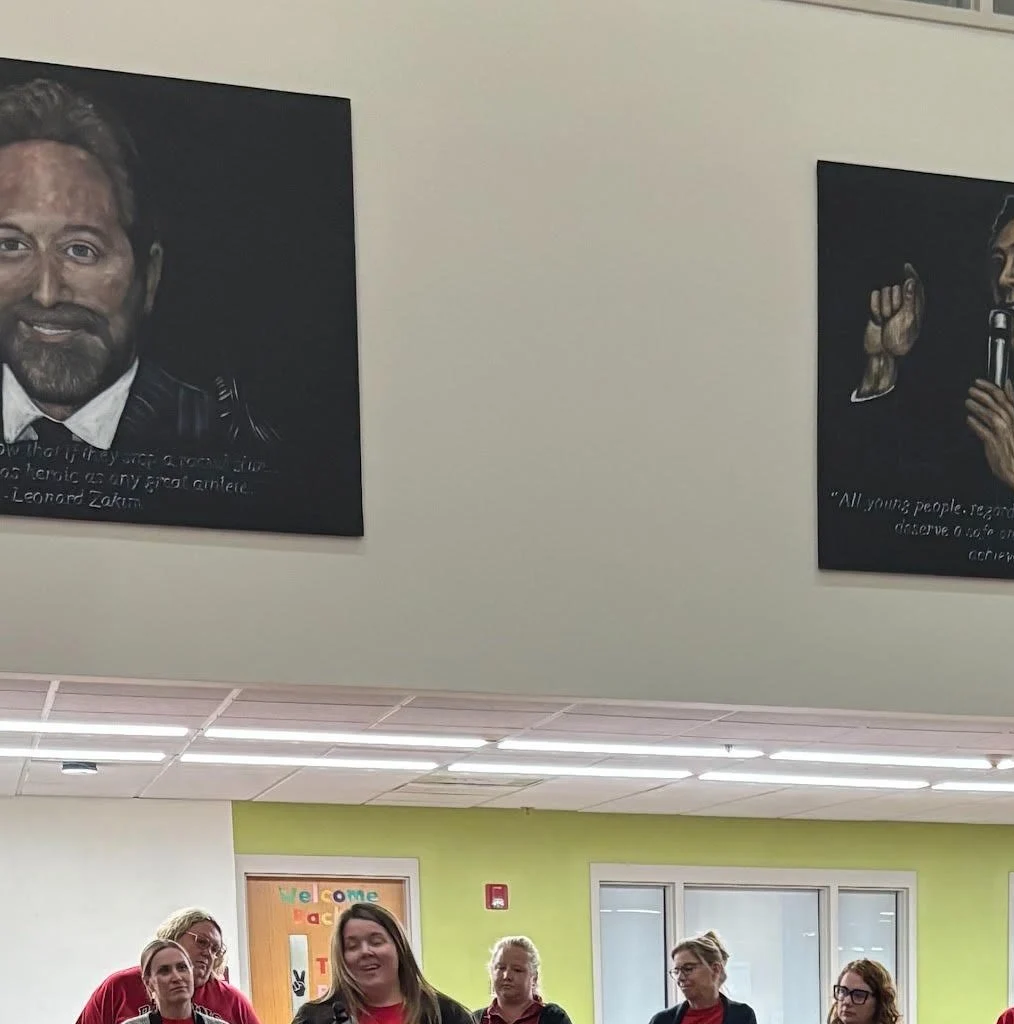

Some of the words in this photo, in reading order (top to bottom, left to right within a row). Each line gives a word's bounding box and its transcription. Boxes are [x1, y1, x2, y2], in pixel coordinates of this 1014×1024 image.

[26, 463, 79, 484] heroic
[85, 471, 104, 484] as
[110, 473, 139, 490] any
[88, 489, 143, 510] Zakim
[863, 497, 911, 515] young
[894, 518, 950, 538] deserve
[953, 524, 962, 538] a
[965, 523, 994, 541] safe
[278, 883, 379, 905] Welcome
